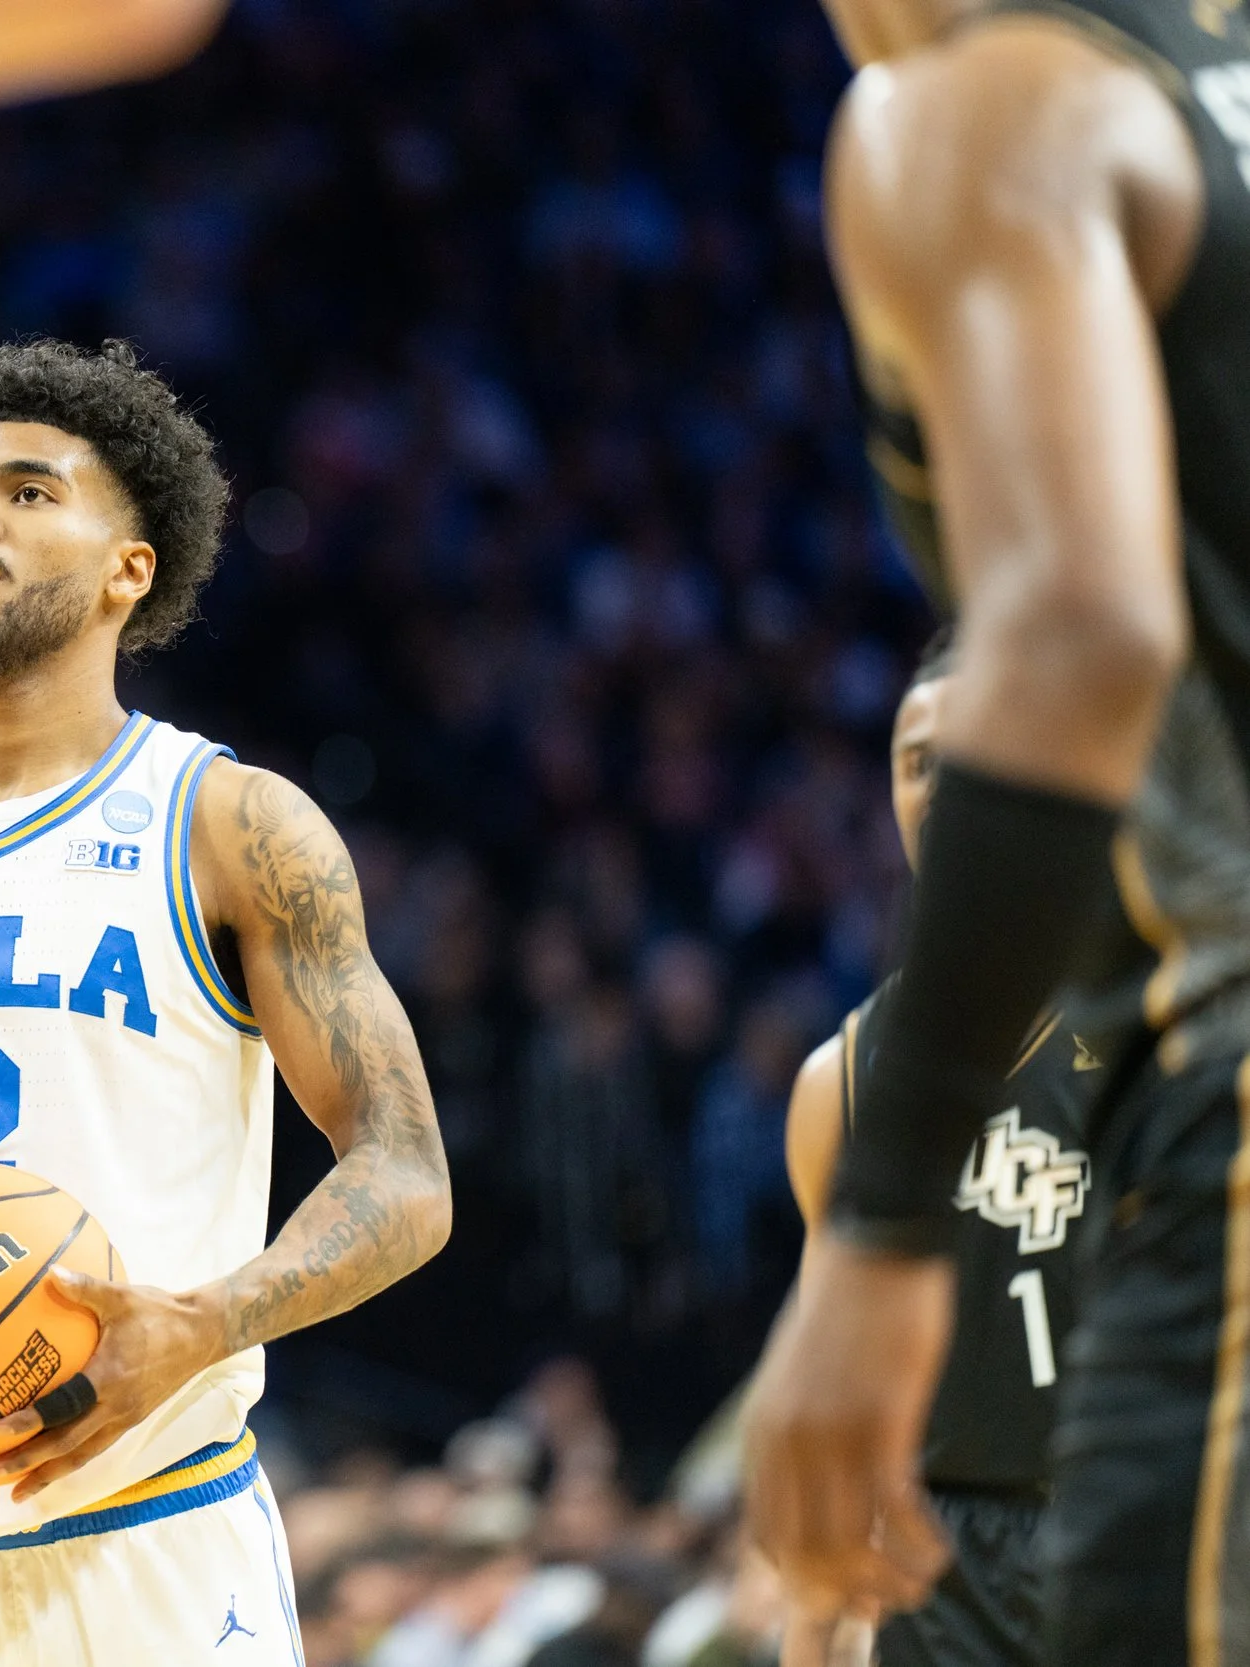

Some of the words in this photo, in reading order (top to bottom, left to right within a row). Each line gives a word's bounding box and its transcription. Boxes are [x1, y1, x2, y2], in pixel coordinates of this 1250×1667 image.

[240, 1267, 306, 1338] FEAR
[303, 1220, 356, 1277] GOD
[1008, 1268, 1056, 1387] 1
